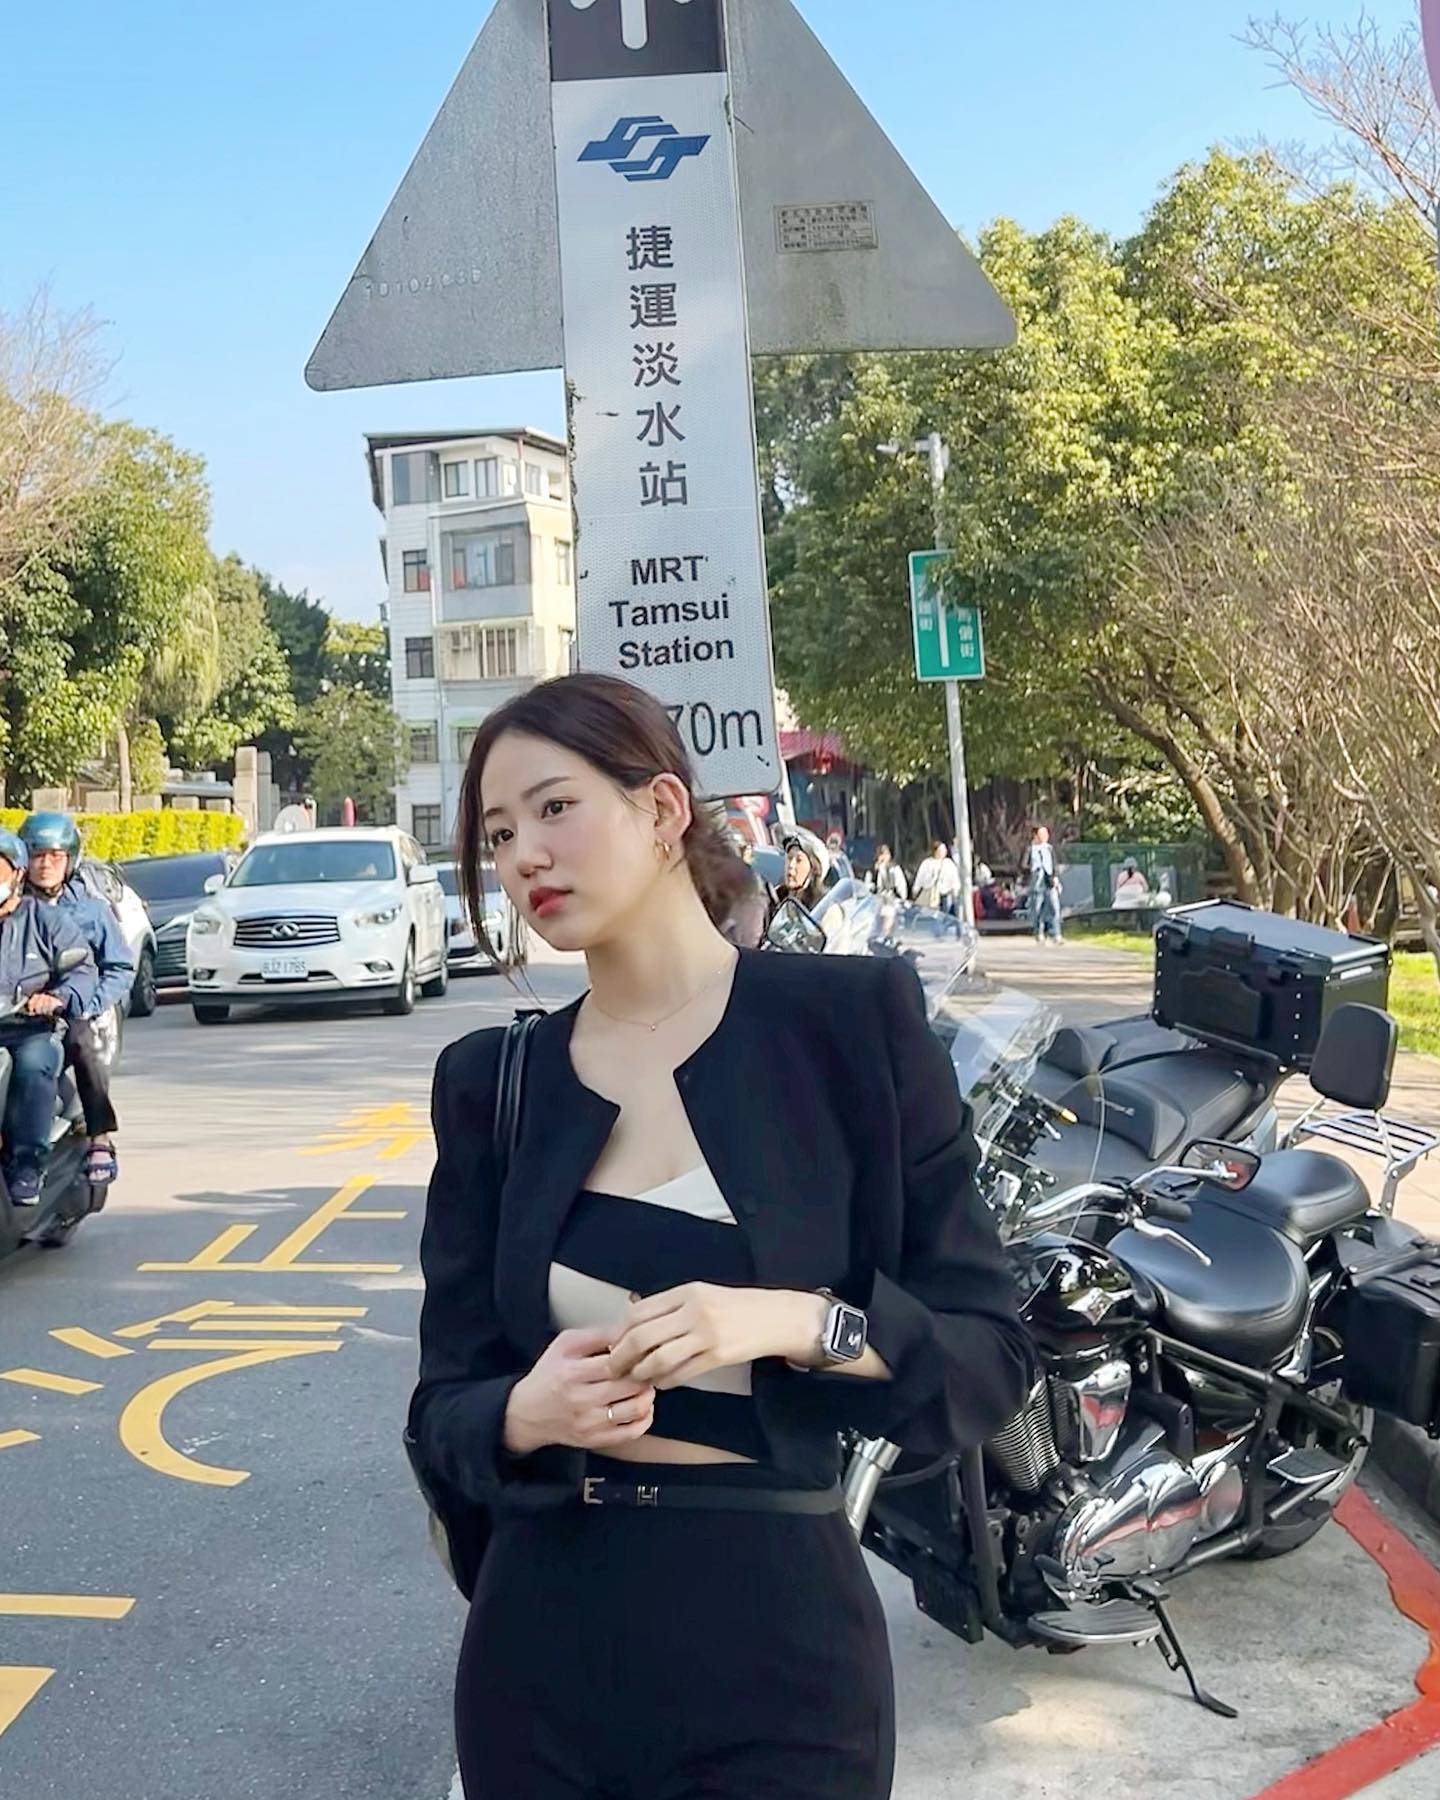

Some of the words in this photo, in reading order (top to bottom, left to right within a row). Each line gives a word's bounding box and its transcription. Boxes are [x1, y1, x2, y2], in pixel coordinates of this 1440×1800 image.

[626, 225, 688, 506] 捷運淡水站
[631, 555, 704, 585] MRT
[609, 593, 729, 627] Tamsui
[619, 636, 734, 669] Station
